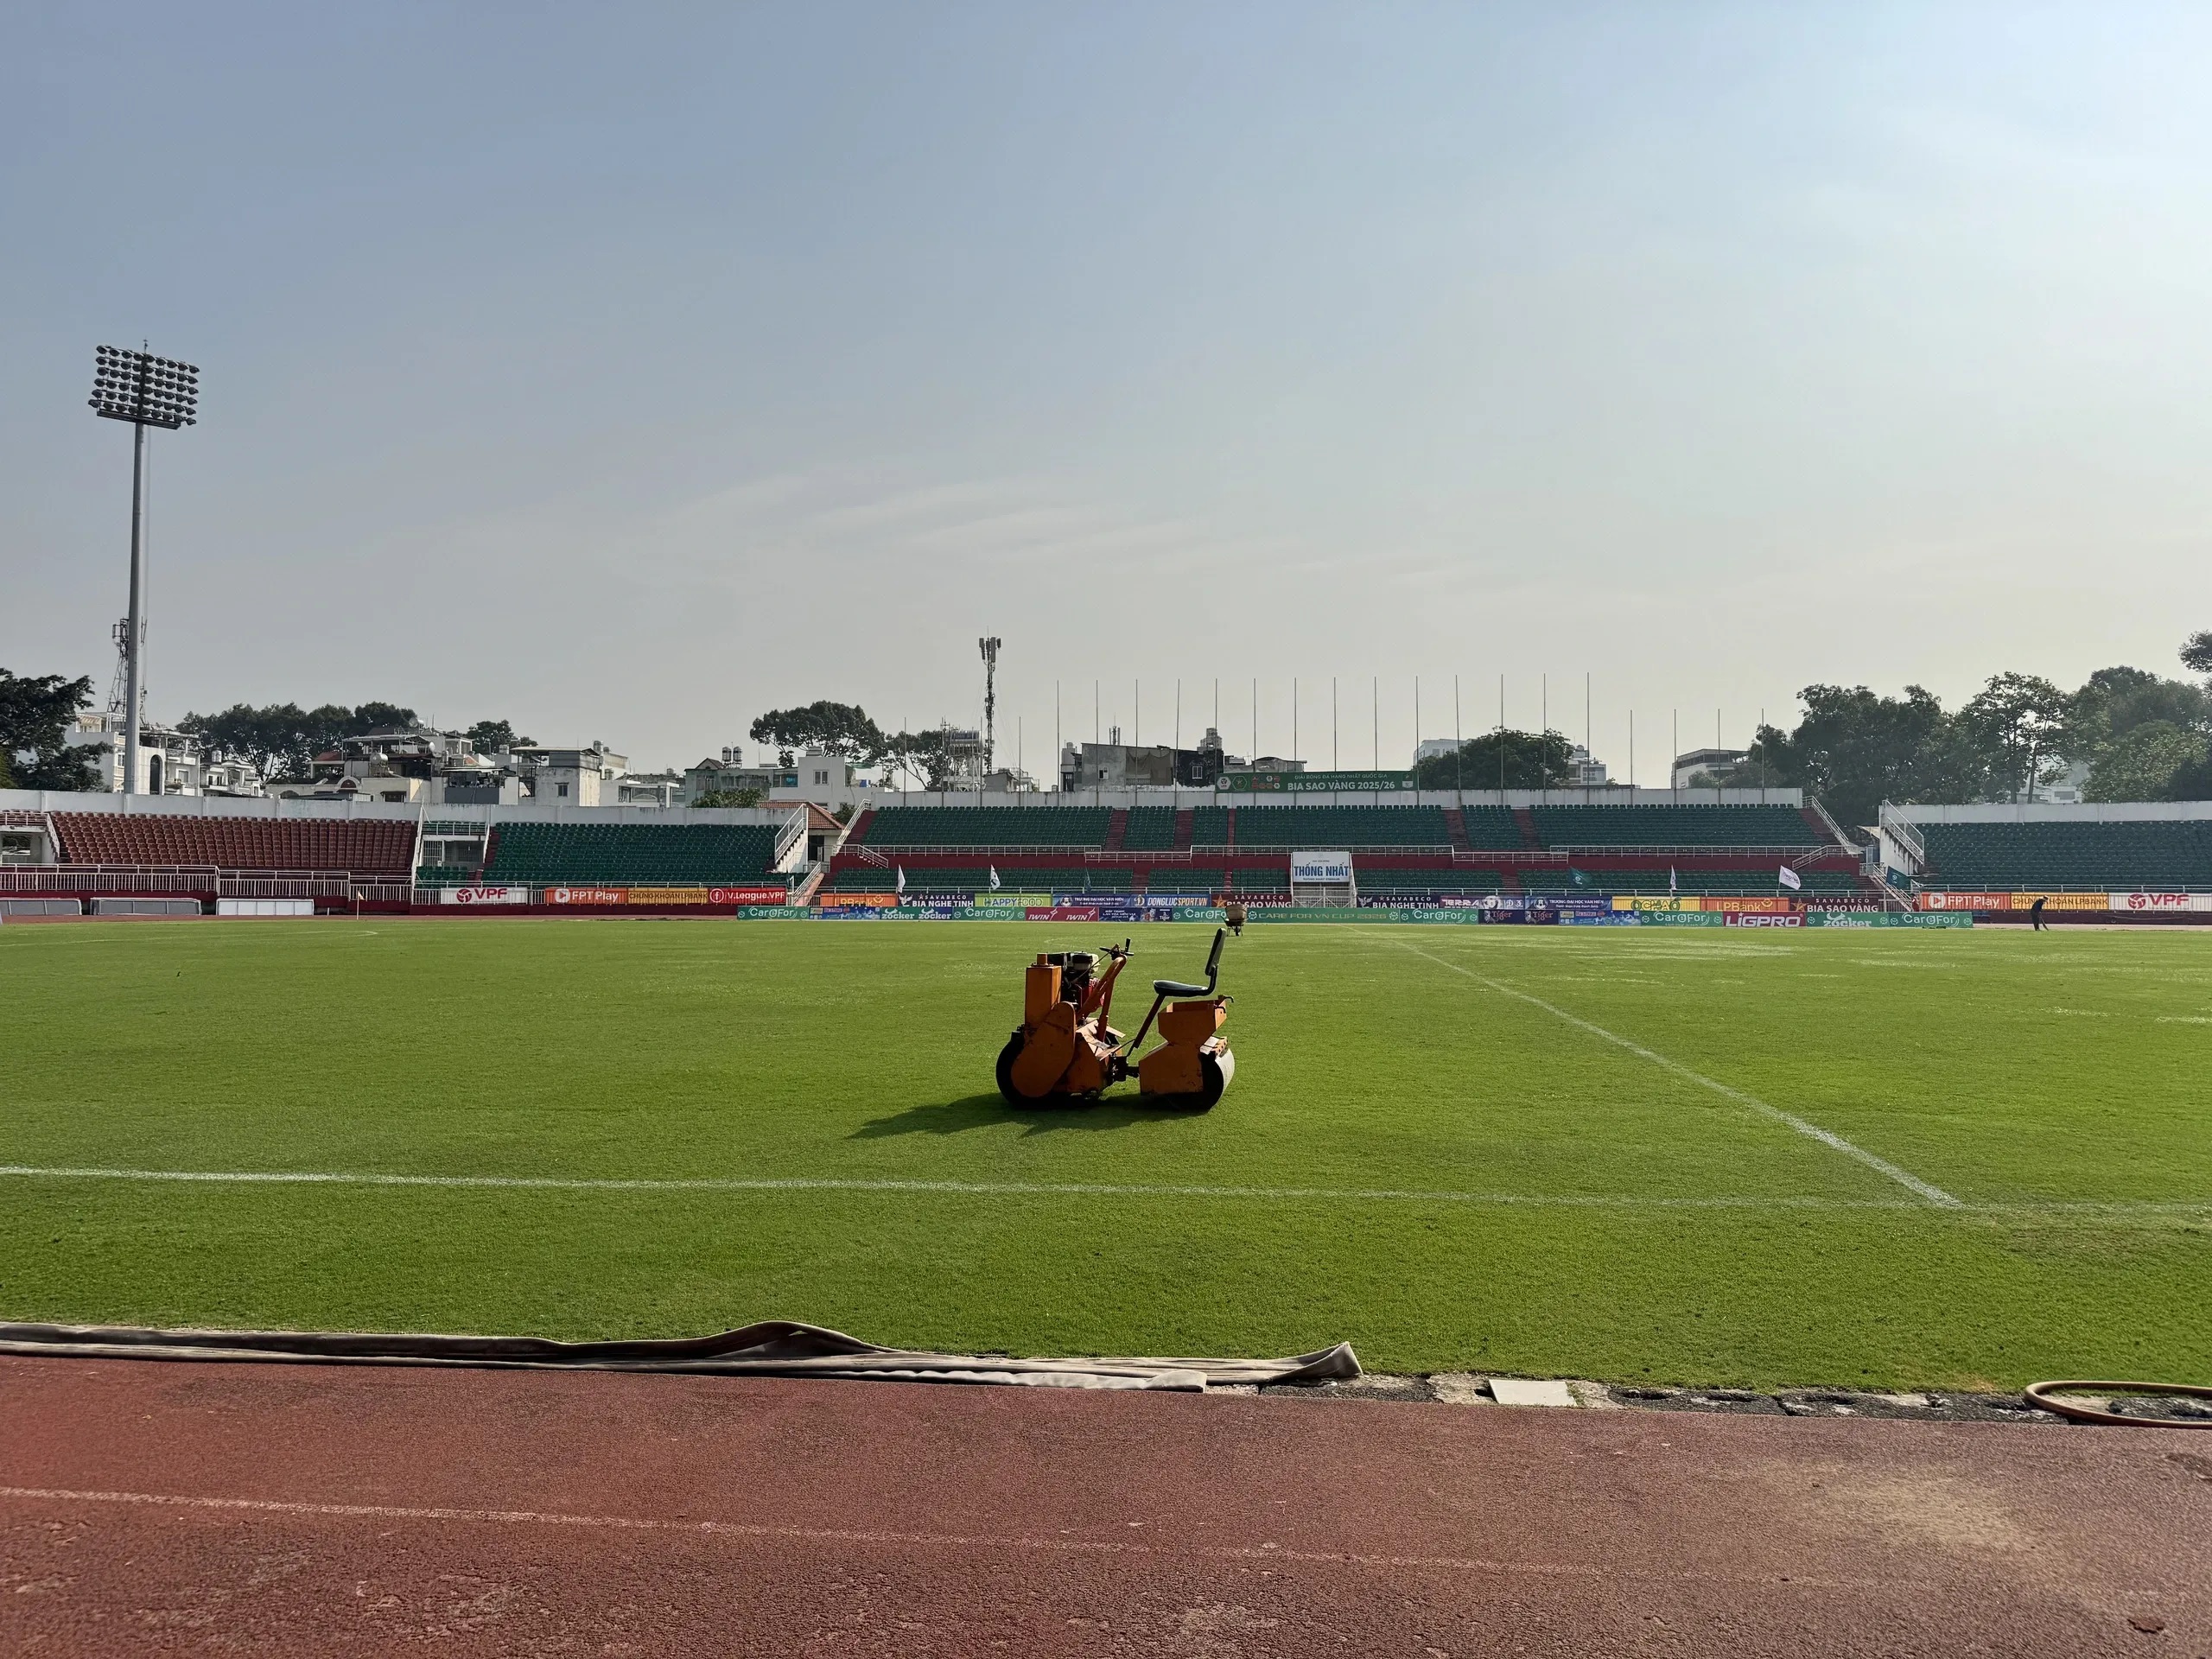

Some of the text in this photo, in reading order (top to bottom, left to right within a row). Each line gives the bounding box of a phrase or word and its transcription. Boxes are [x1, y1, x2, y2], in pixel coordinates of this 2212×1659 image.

[1287, 782, 1304, 791] BIA
[1327, 779, 1356, 790] VÀNG
[1357, 781, 1395, 790] 2025/26
[1294, 862, 1350, 876] THỐNG NHẤT
[474, 887, 508, 899] VPF
[572, 891, 619, 902] FPT Play
[728, 892, 785, 901] V.League.VPF
[1147, 897, 1209, 906] DONGLUCSPORT.VN
[1948, 895, 2000, 908] FPT Play
[2147, 893, 2190, 906] VPF
[1717, 900, 1762, 912] LPBank
[1847, 904, 1878, 912] VÀNG
[1185, 908, 1227, 919] CareFo
[1491, 910, 1514, 921] Tiger
[1532, 911, 1554, 921] Tiger
